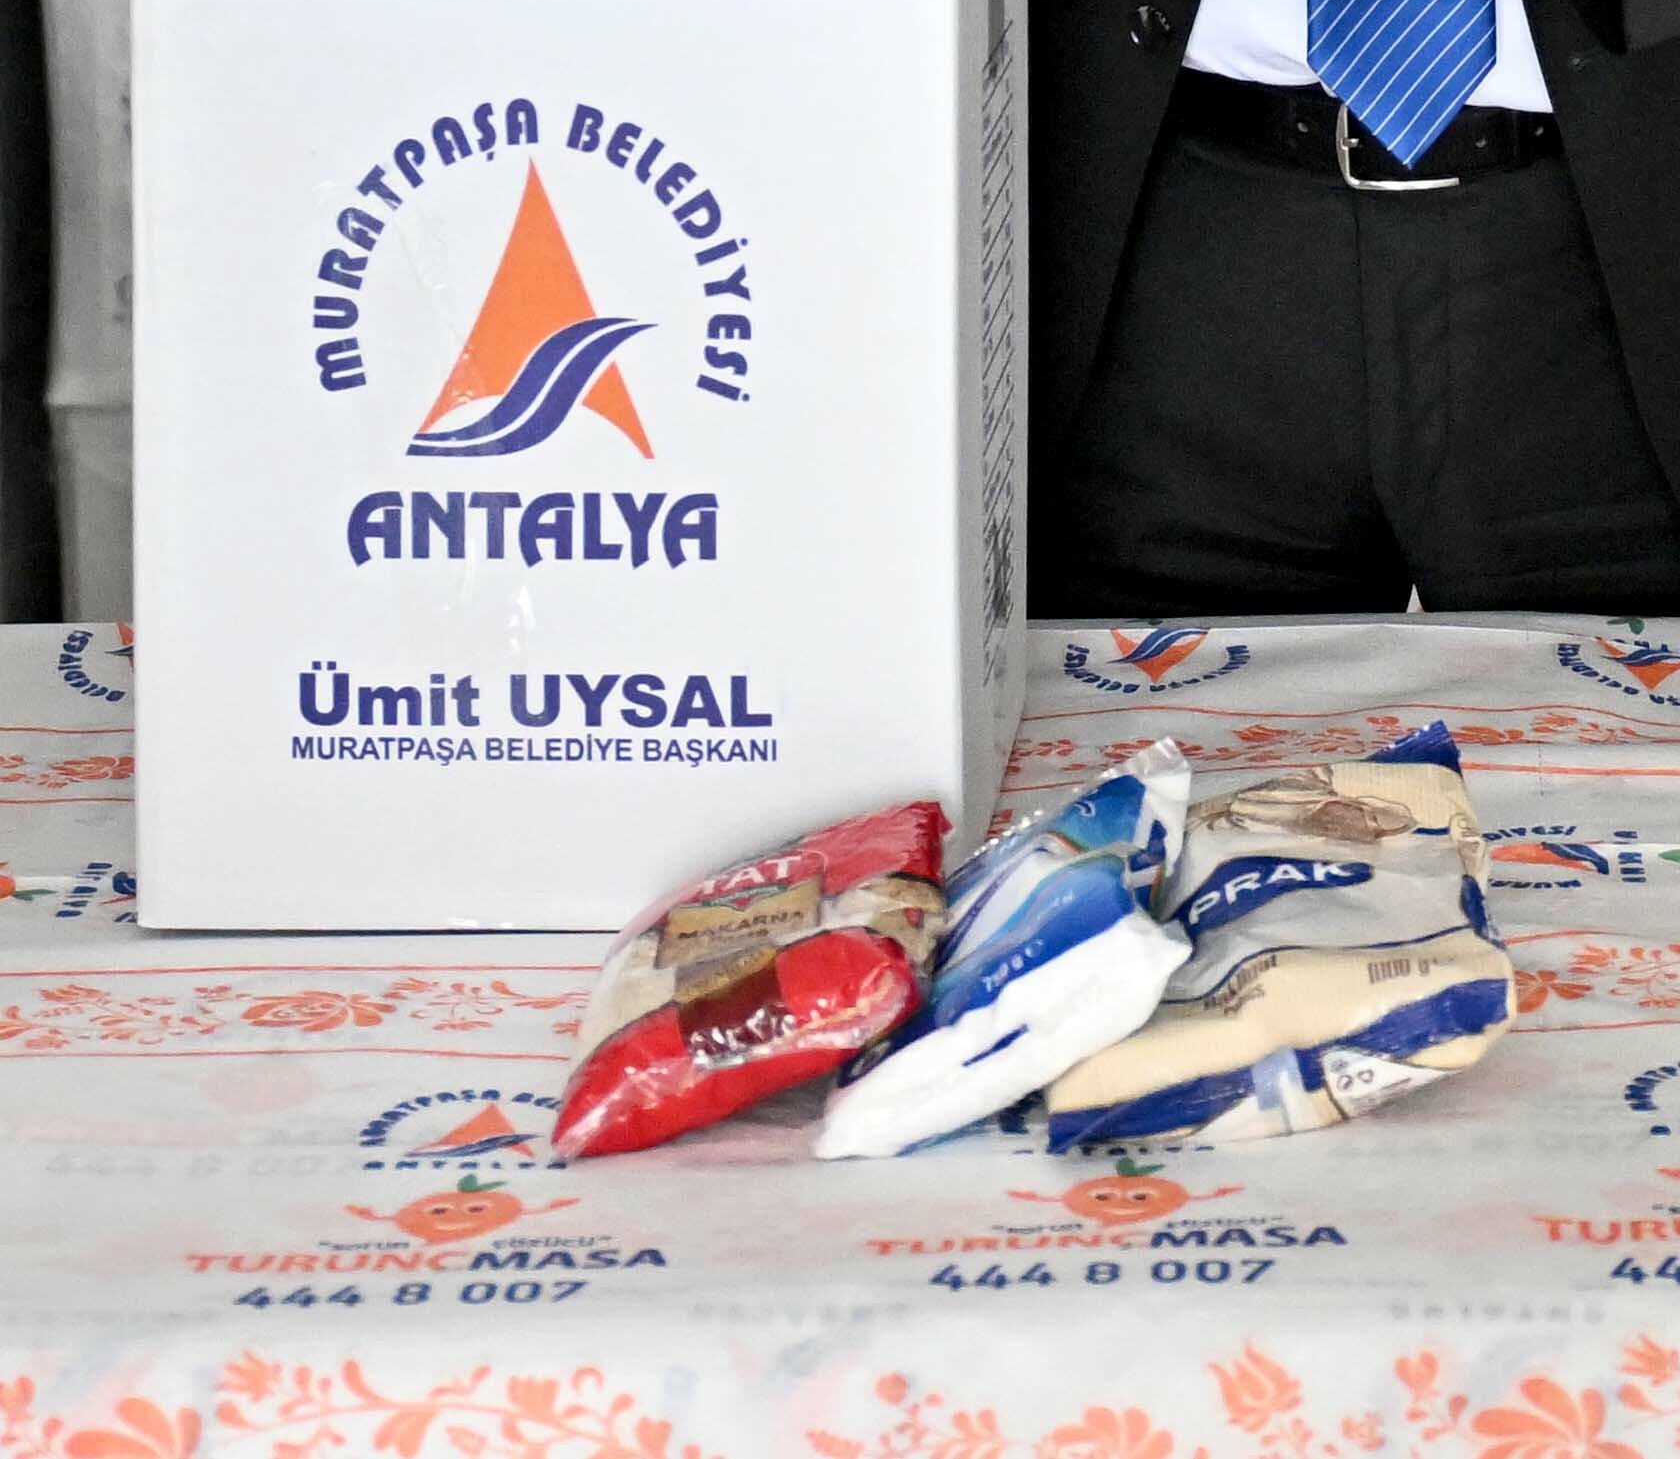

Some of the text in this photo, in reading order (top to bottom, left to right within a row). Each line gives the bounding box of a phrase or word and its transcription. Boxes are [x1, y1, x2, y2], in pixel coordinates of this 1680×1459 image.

[310, 97, 540, 393] MURATPAŞA
[565, 102, 753, 403] BELEDİYESİ
[347, 490, 720, 569] ANTALYA
[296, 660, 772, 727] Ümit UYSAL
[290, 730, 778, 768] MURATPAŞA BELEDİYE BAŞKANI
[1187, 860, 1353, 925] PRAK
[232, 1278, 591, 1311] 444 8 007
[927, 1257, 1277, 1292] 444 8 007
